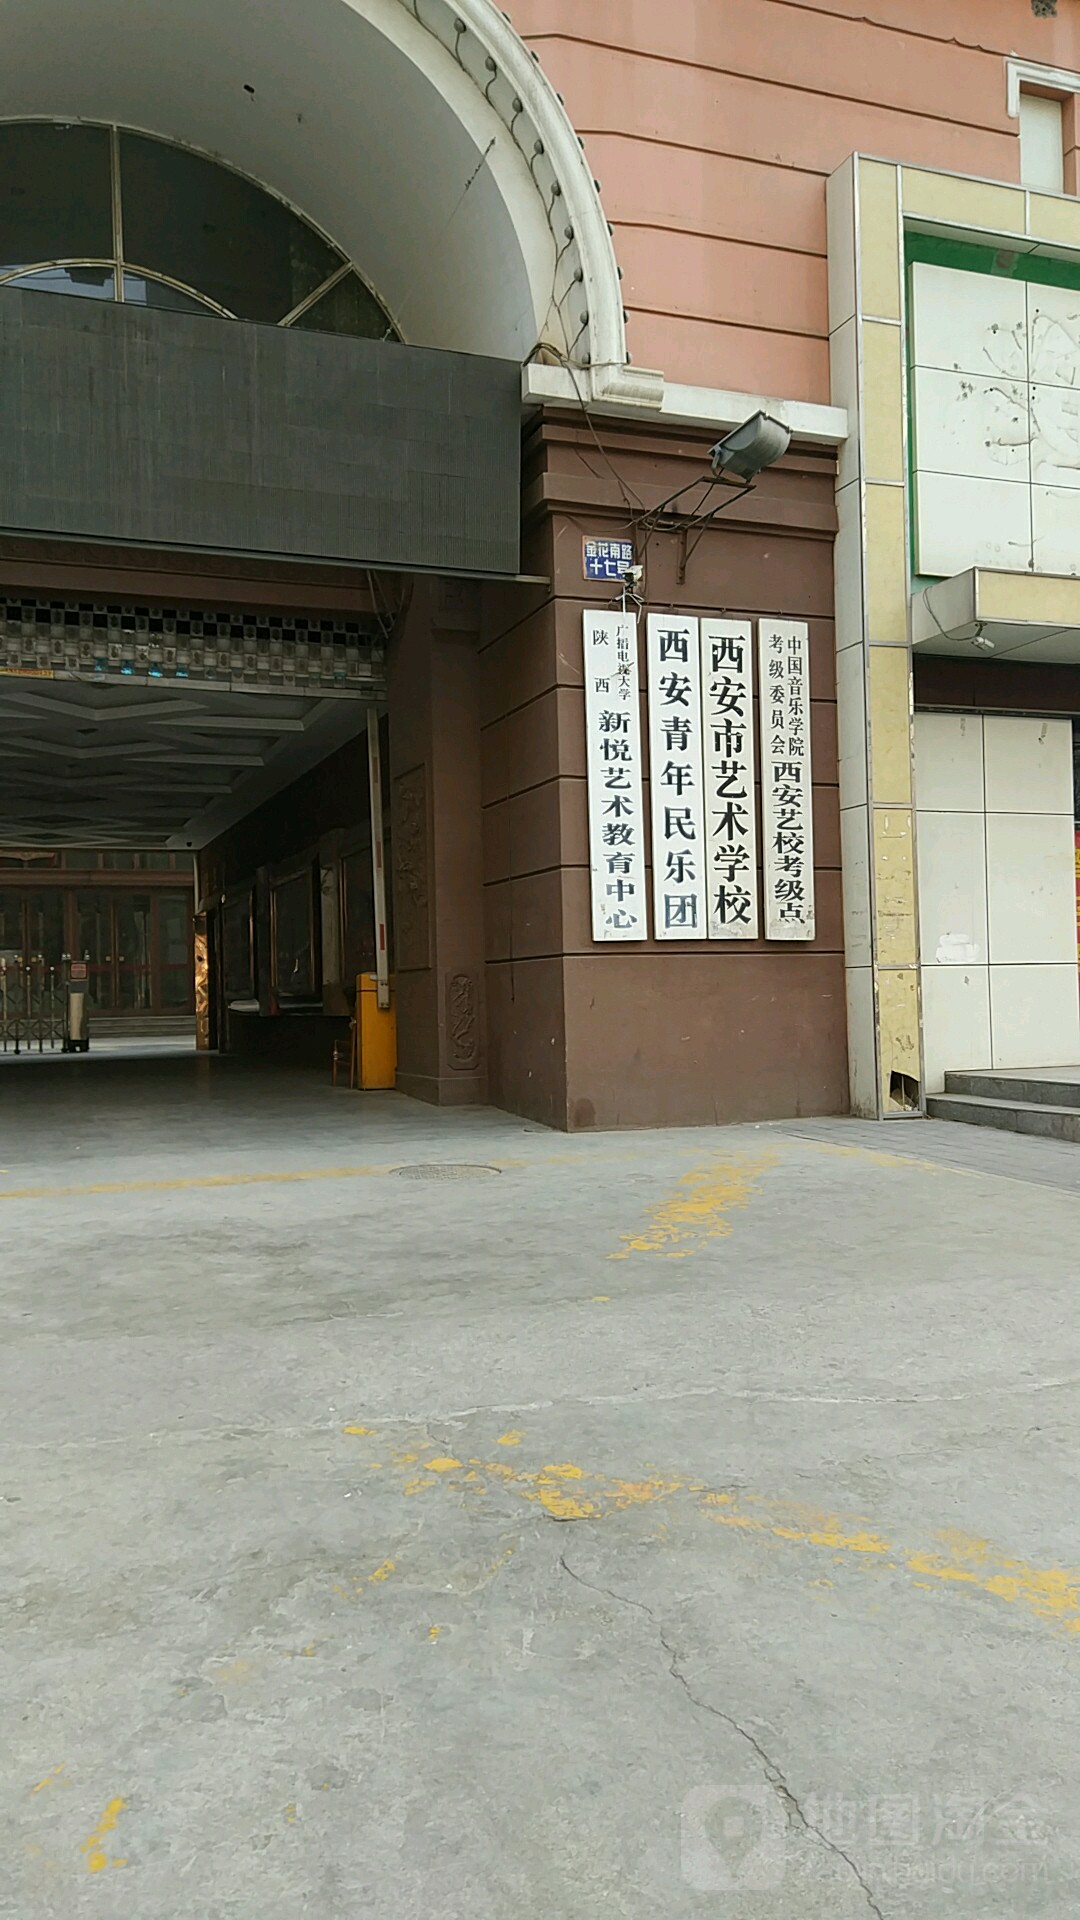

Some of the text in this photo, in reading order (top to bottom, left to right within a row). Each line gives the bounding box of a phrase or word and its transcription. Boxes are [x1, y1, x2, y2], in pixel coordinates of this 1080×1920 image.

[586, 541, 633, 560] 金花南路
[592, 629, 611, 693] 陕西
[768, 634, 786, 755] 考级委员会
[787, 635, 805, 757] 中国音乐学院
[598, 709, 639, 929] 新悦艺术教育中心
[657, 628, 698, 929] 西安青年民乐团
[708, 635, 752, 925] 西安市艺术学校
[771, 761, 806, 925] 西安艺校考级点
